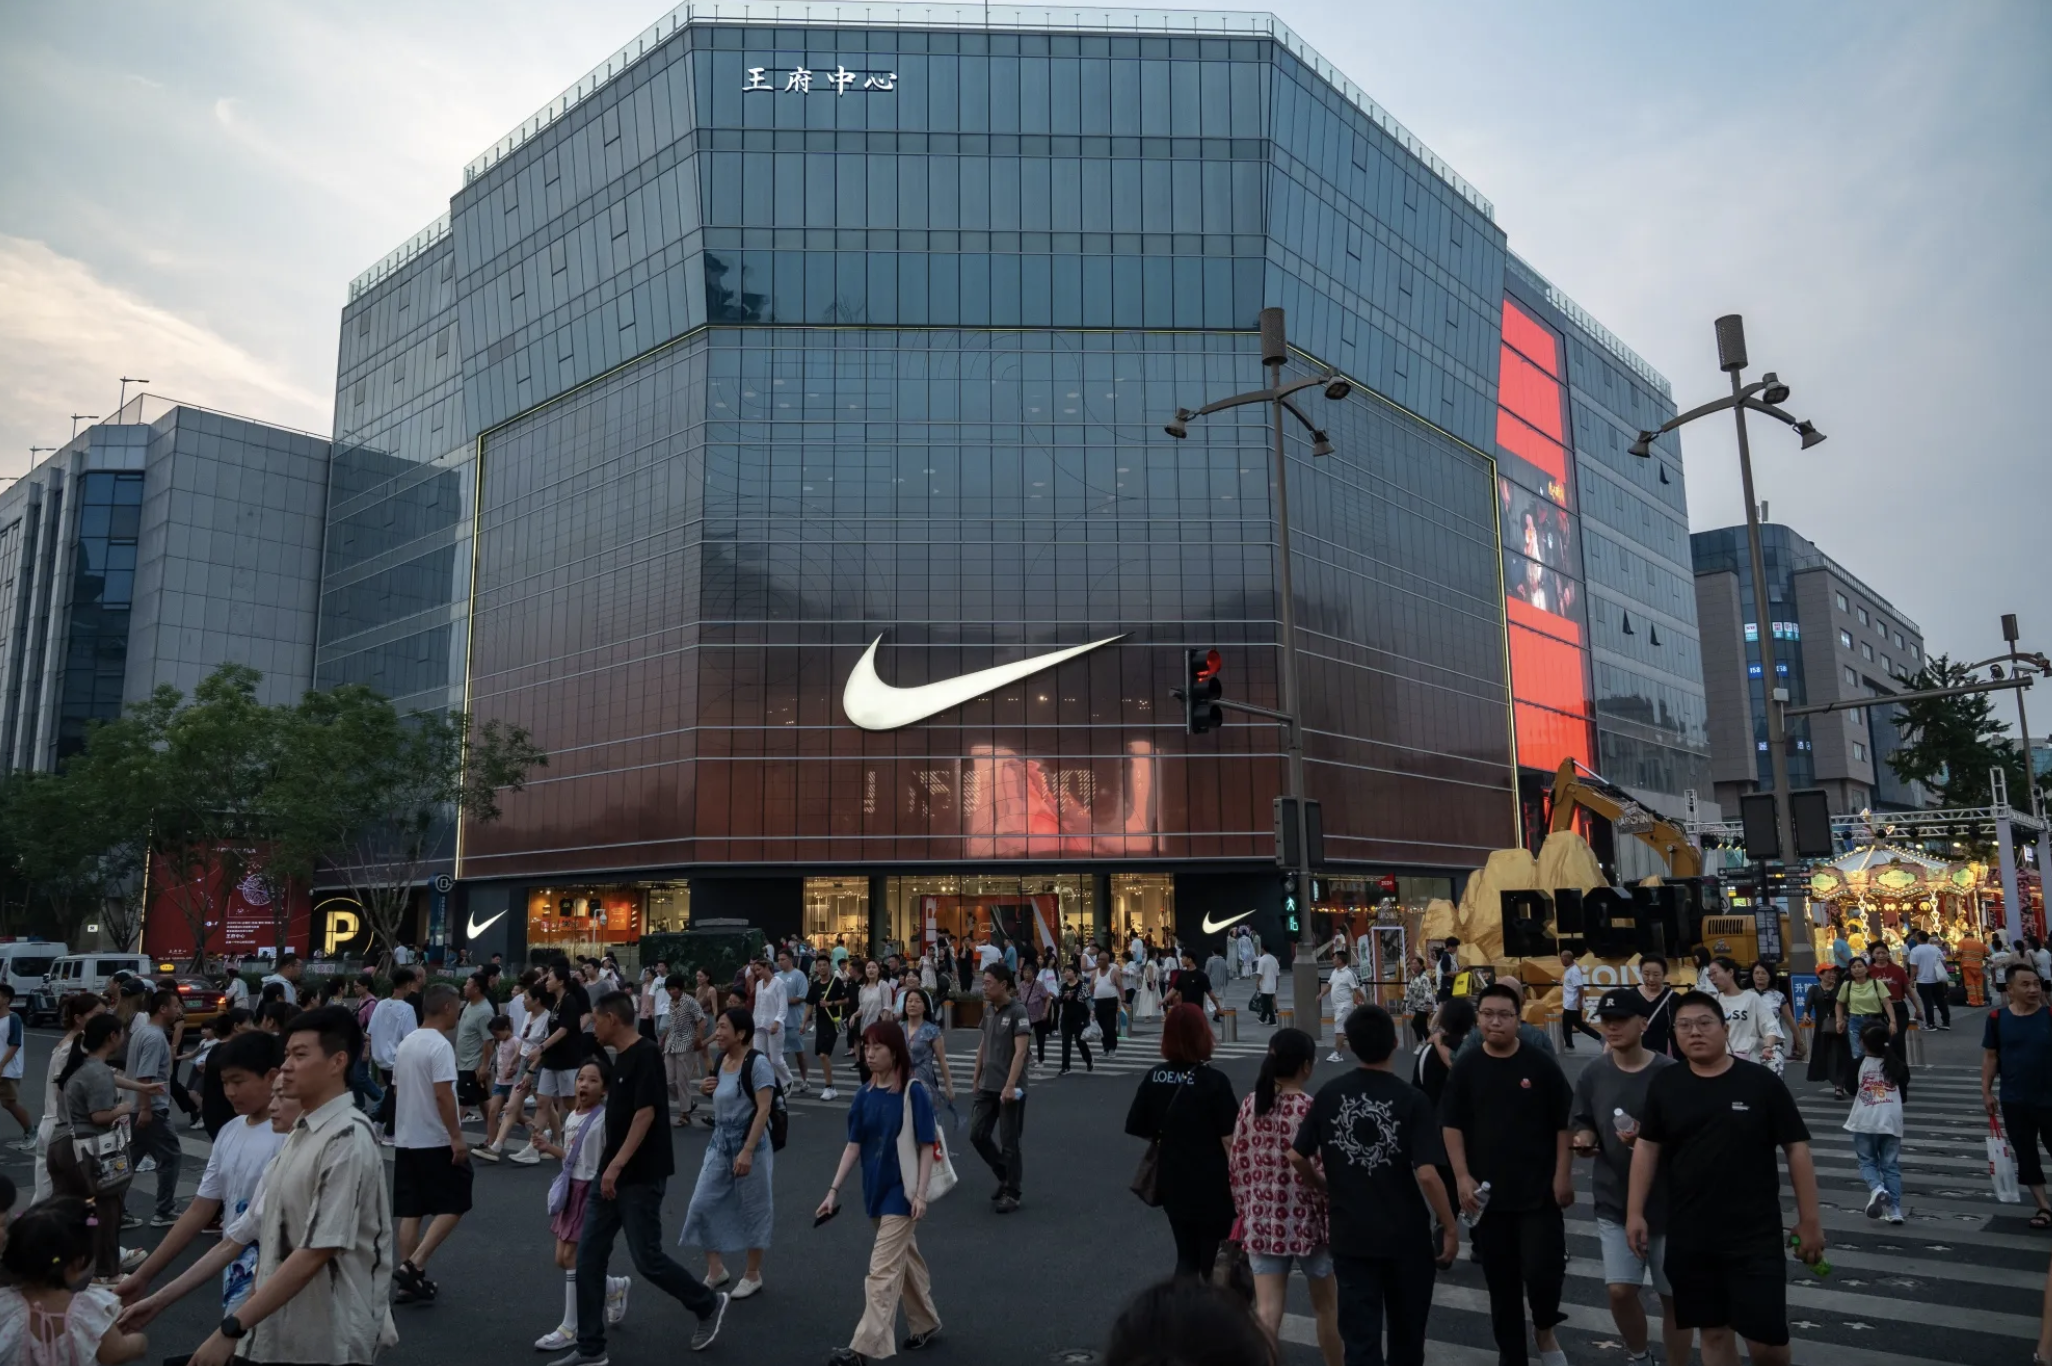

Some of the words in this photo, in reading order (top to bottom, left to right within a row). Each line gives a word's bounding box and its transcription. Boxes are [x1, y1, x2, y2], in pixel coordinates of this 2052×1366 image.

[742, 66, 898, 96] 王府中心
[324, 911, 360, 958] P
[1605, 998, 1615, 1007] R
